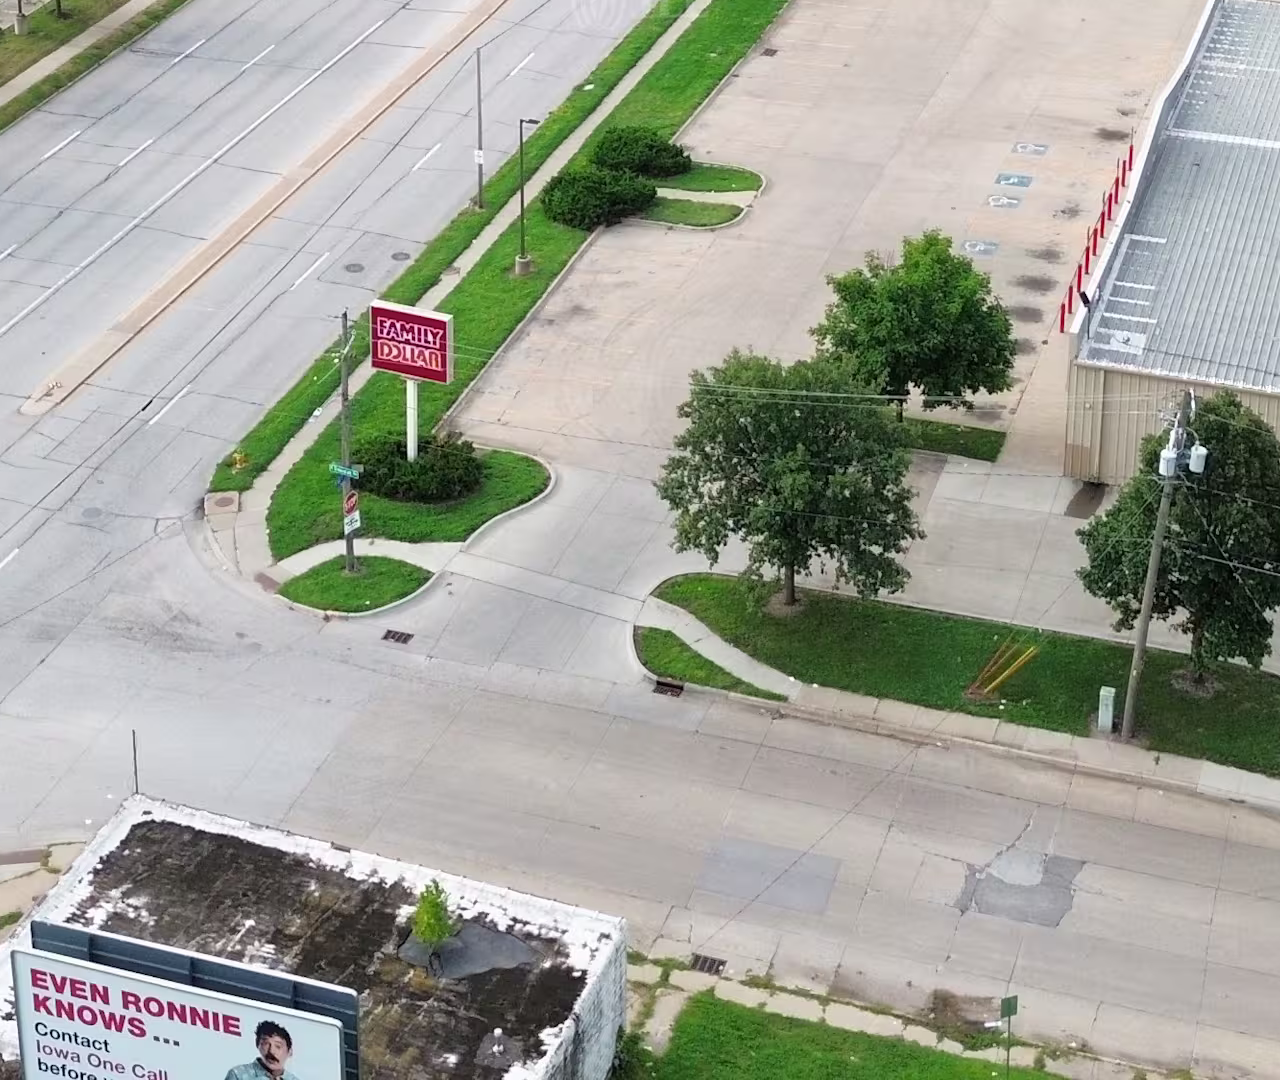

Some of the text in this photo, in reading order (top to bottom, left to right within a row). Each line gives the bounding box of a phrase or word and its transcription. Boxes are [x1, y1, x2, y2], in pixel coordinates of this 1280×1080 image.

[377, 316, 444, 349] FAMILY
[377, 338, 442, 372] DOLLAR
[30, 967, 242, 1038] EVEN RONNIE
[34, 1021, 111, 1053] Contact
[36, 1039, 168, 1080] Iowa One Call
